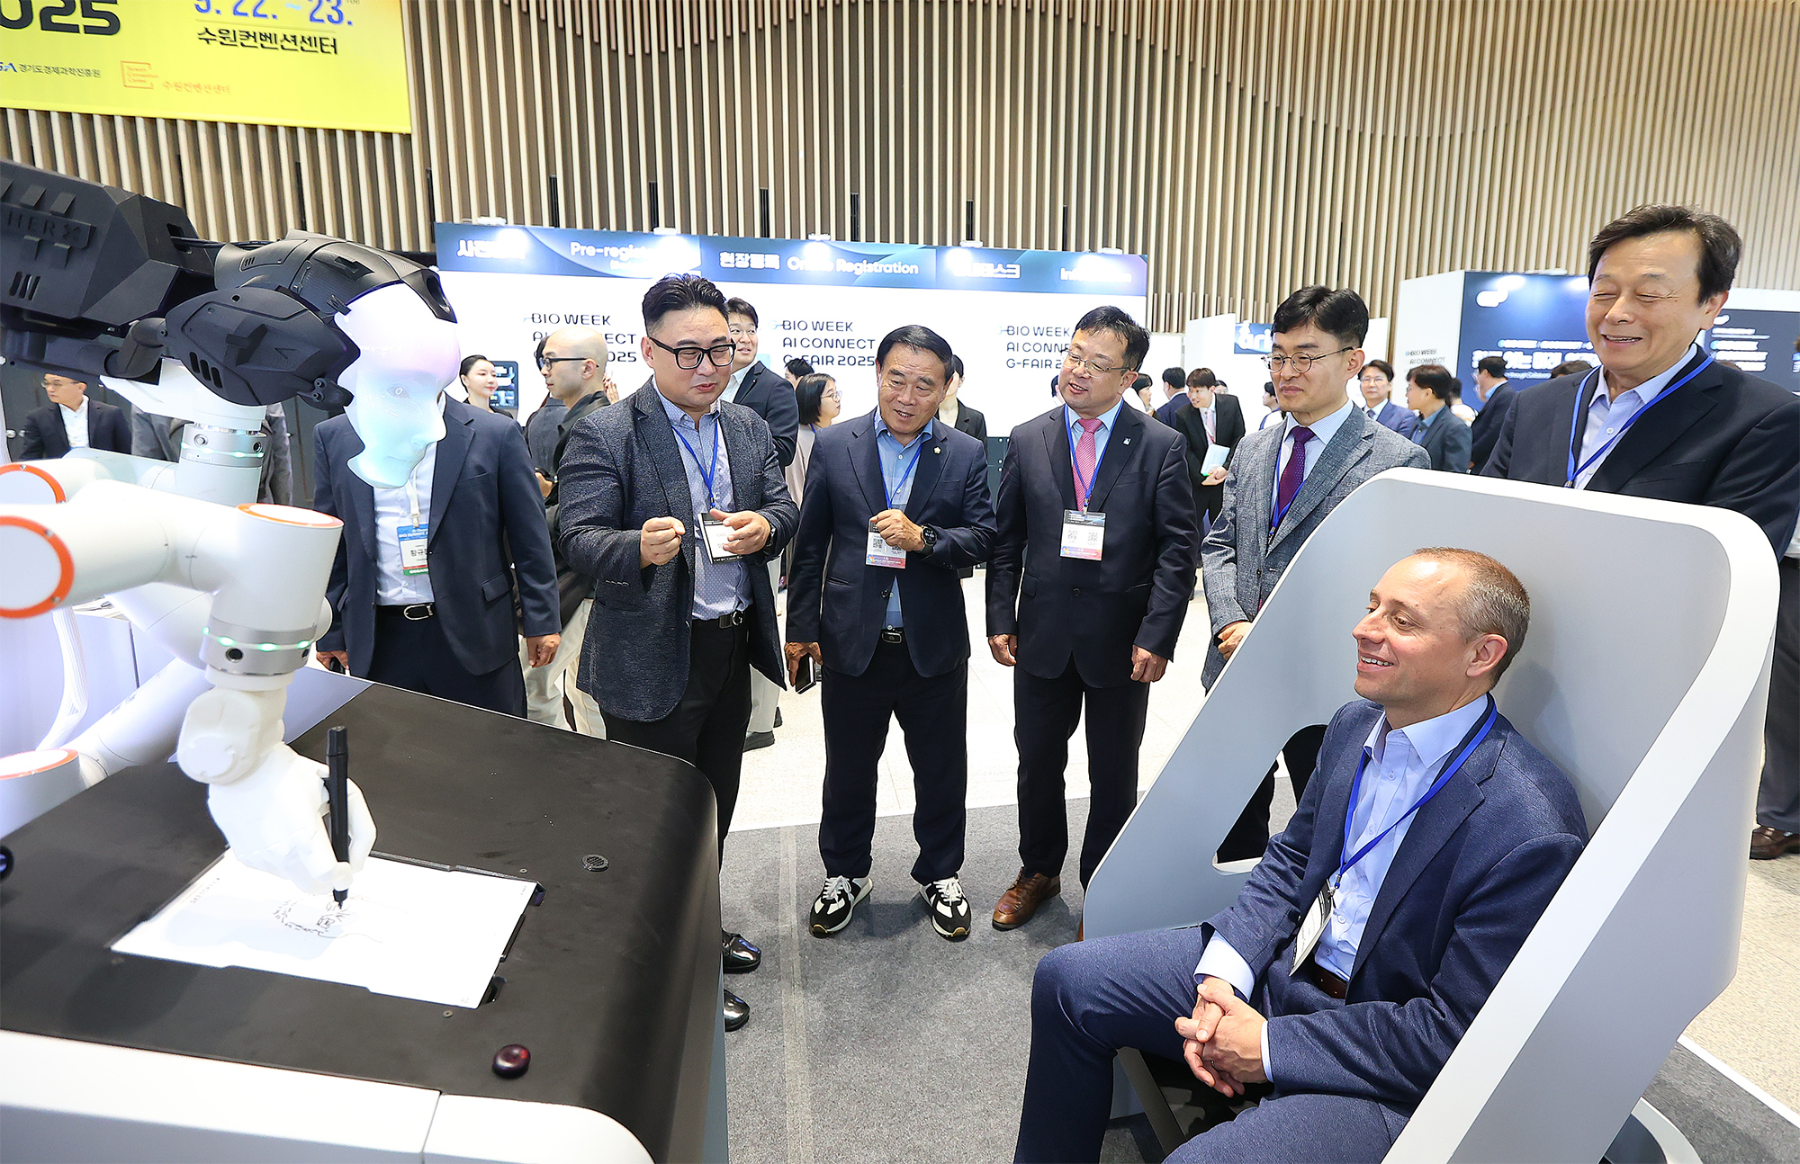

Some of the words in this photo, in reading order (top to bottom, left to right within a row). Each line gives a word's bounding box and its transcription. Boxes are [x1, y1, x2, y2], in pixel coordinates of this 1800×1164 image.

[197, 27, 338, 55] 수원컨벤션센터
[835, 258, 919, 276] Registration
[564, 314, 611, 326] WEEK
[811, 321, 854, 332] WEEK
[1033, 326, 1070, 337] WEEK
[783, 336, 797, 348] AI
[800, 337, 876, 350] CONNECT
[1006, 341, 1019, 352] AI
[837, 355, 876, 367] 2025
[1006, 358, 1053, 369] G-FAIR
